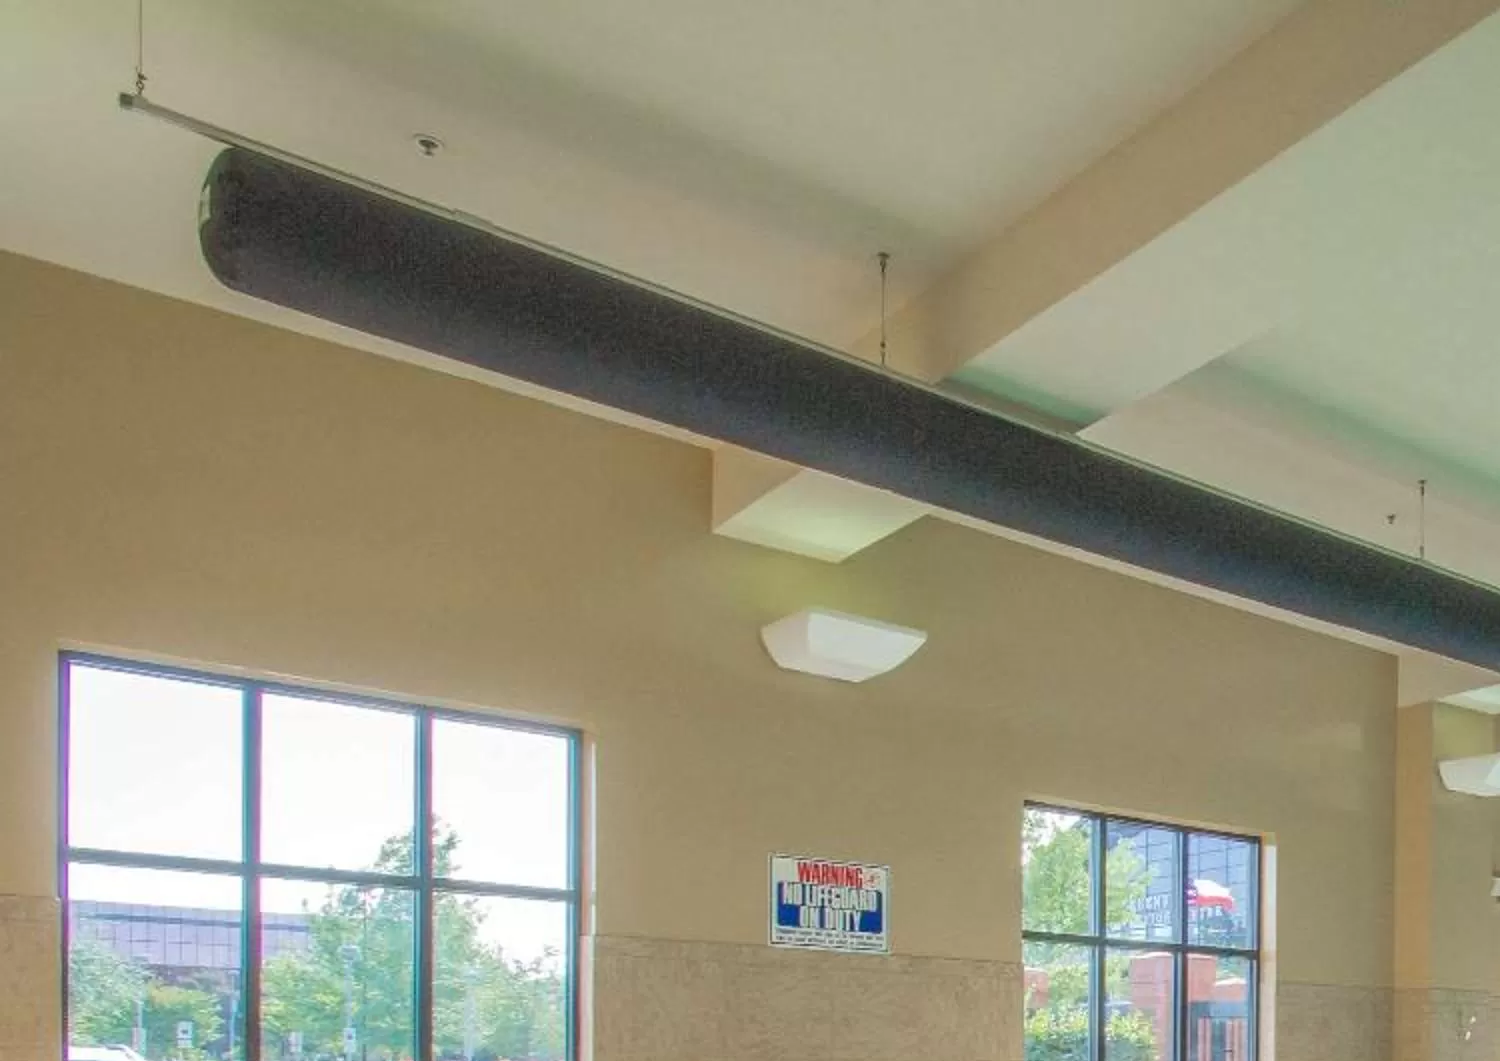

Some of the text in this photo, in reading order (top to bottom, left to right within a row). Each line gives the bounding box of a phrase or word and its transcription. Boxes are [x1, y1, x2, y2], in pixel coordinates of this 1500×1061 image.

[797, 861, 864, 888] WARNING
[783, 882, 877, 912] NO LIFEGUARD
[799, 905, 862, 931] ON DUTY
